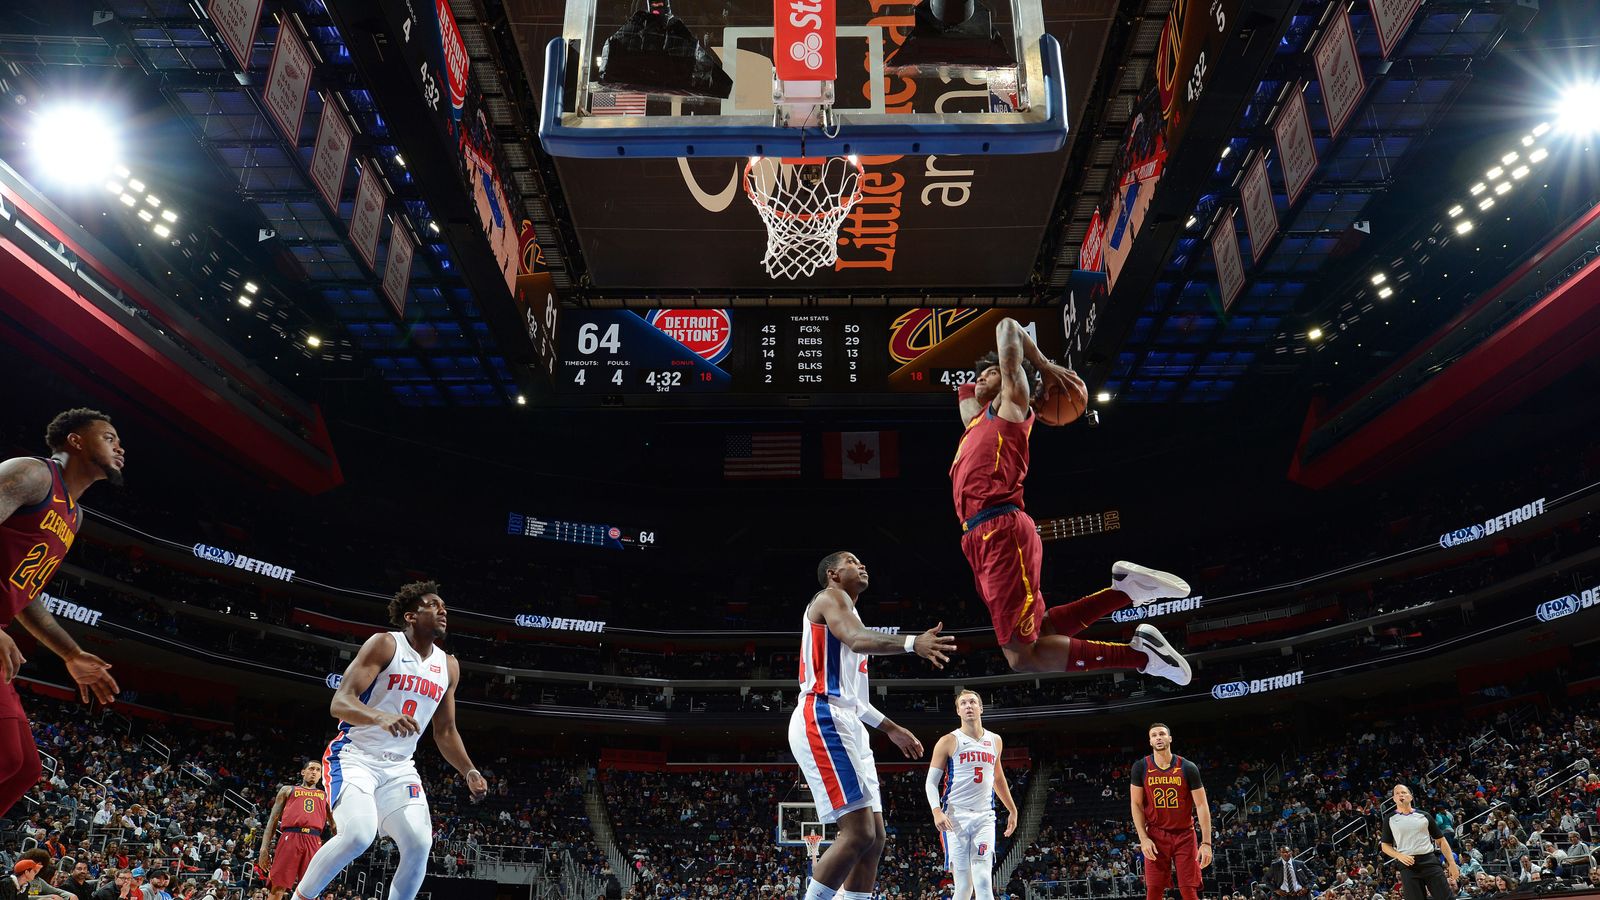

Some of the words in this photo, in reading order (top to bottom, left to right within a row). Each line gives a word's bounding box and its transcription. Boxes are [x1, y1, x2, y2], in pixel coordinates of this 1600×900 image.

[790, 0, 822, 30] St
[1216, 3, 1226, 33] 5
[402, 17, 411, 43] 4
[1187, 51, 1207, 102] 4:32
[421, 61, 440, 112] 4:32
[835, 172, 905, 272] Little
[664, 316, 719, 328] DETROIT
[761, 325, 776, 333] 43
[800, 325, 821, 333] FG%
[844, 324, 860, 333] 50
[578, 322, 621, 355] 64
[761, 337, 776, 346] 25
[797, 337, 823, 345] REBS
[845, 337, 860, 345] 29
[762, 349, 775, 358] 14
[797, 350, 823, 358] ASTS
[846, 349, 858, 358] 13
[765, 362, 772, 370] 5
[797, 362, 823, 370] BLKS
[849, 361, 857, 370] 3
[574, 369, 586, 386] 4
[611, 369, 623, 386] 4
[645, 371, 682, 387] 4:32
[700, 373, 712, 382] 18
[765, 374, 772, 383] 2
[798, 374, 823, 383] STLS
[849, 374, 857, 383] 5
[910, 372, 923, 381] 18
[940, 370, 976, 385] 4:32
[1449, 527, 1475, 540] FOX
[1485, 497, 1546, 536] DETROIT
[639, 531, 655, 545] 64
[9, 542, 61, 600] 24
[203, 545, 225, 559] FOX
[235, 554, 296, 583] DETROIT
[1120, 607, 1139, 618] FOX
[1148, 596, 1203, 617] DETROIT
[1545, 597, 1571, 614] FOX
[1581, 585, 1600, 609] DE
[551, 617, 606, 633] DETROIT
[387, 674, 444, 704] PISTONS
[1220, 682, 1240, 693] FOX
[1250, 670, 1304, 694] DETROIT
[959, 751, 995, 765] PISTONS
[973, 767, 983, 784] 5
[1148, 776, 1182, 786] CLEVELAND
[294, 789, 325, 801] CLEVELAND
[1153, 788, 1179, 809] 22
[303, 798, 315, 813] 8
